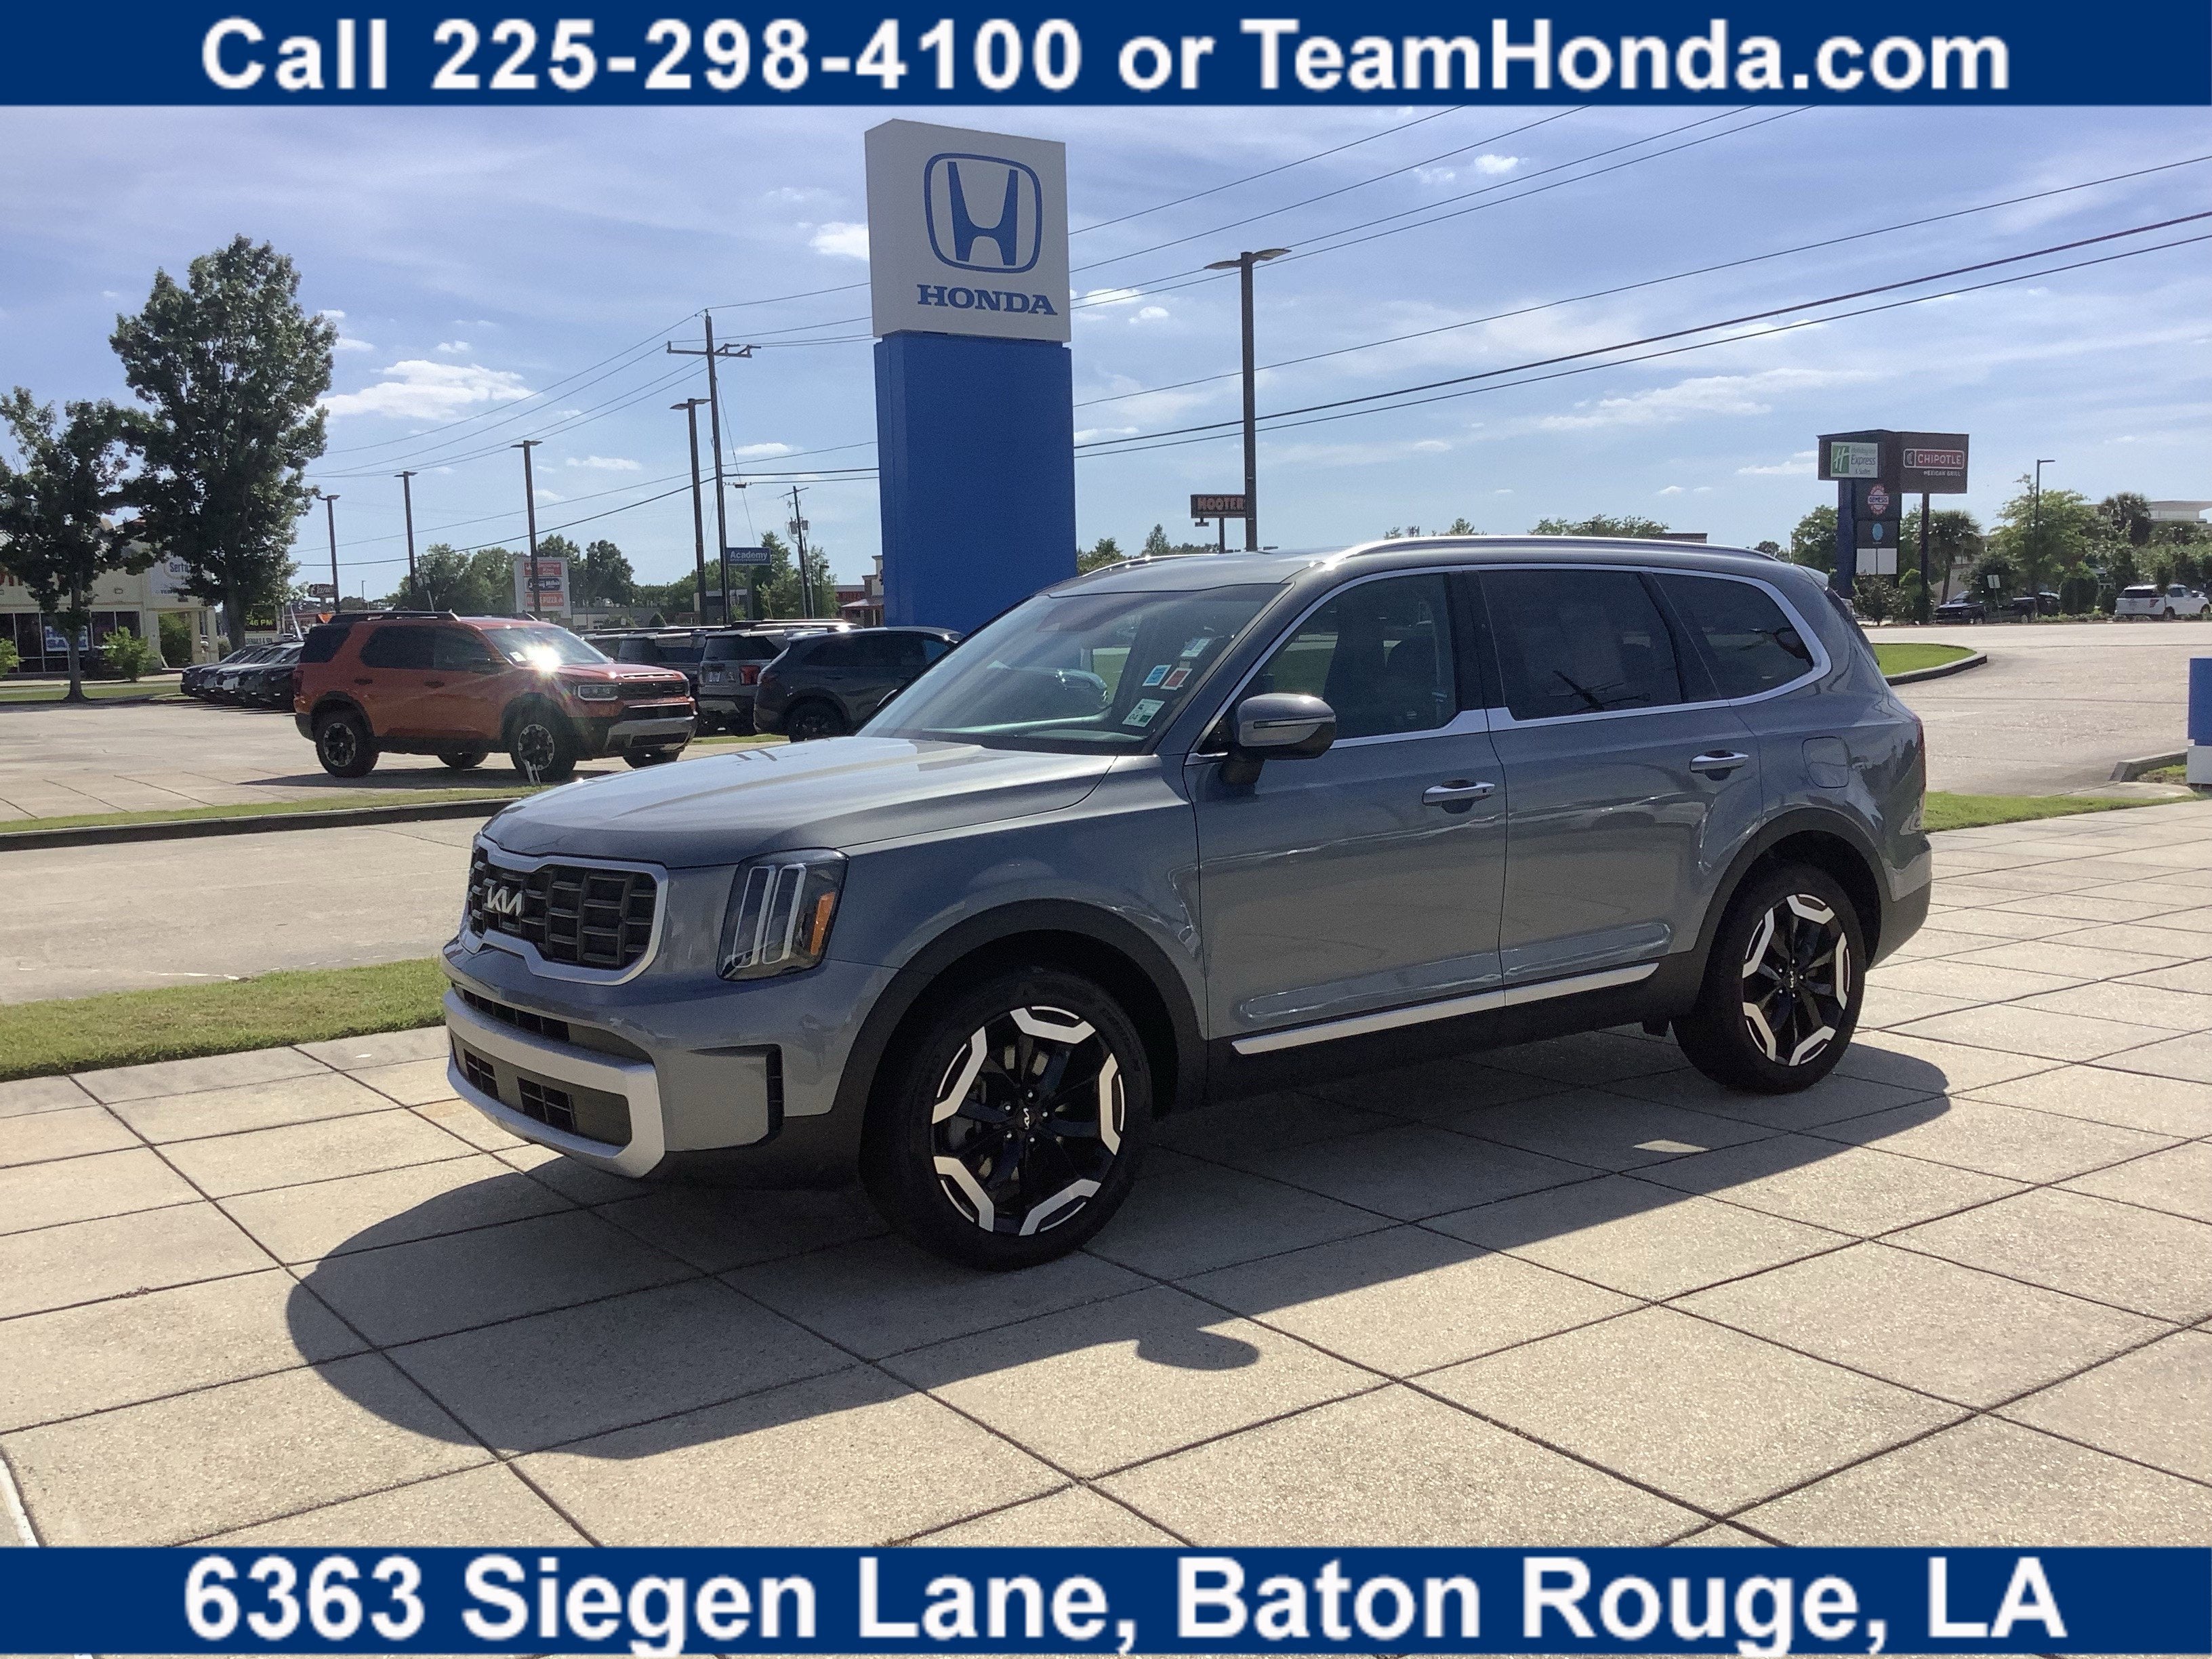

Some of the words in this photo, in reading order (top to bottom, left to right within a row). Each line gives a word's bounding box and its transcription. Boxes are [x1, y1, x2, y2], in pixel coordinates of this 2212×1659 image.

[917, 284, 1058, 315] HONDA
[1851, 454, 1876, 468] Express
[1917, 453, 1962, 465] CHIPOTLE
[1197, 497, 1246, 510] HOOTER
[730, 550, 768, 561] Academy
